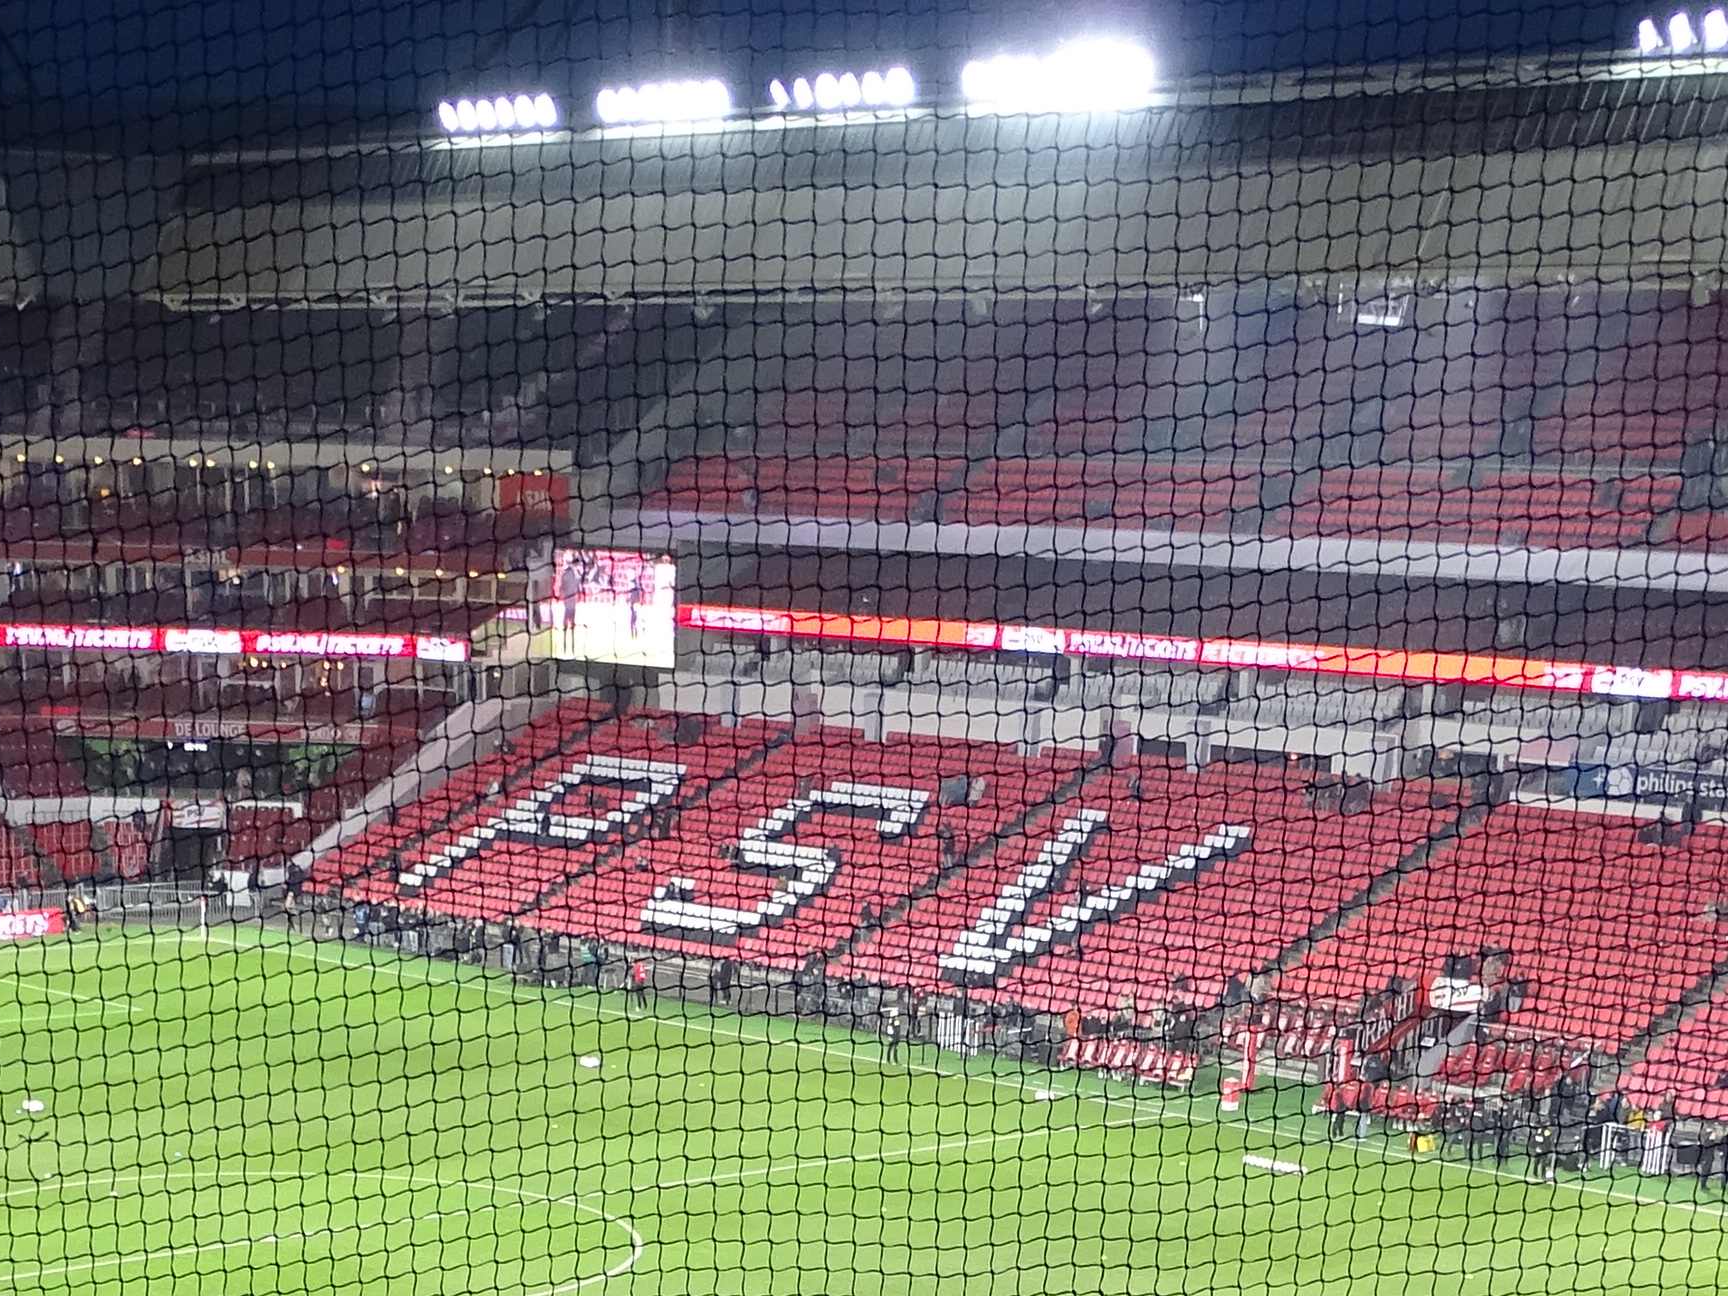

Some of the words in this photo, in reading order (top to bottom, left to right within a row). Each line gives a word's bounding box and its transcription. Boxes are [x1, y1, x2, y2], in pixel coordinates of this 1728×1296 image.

[175, 722, 193, 737] DE
[195, 723, 247, 738] LOUNGE
[1635, 772, 1696, 799] philips
